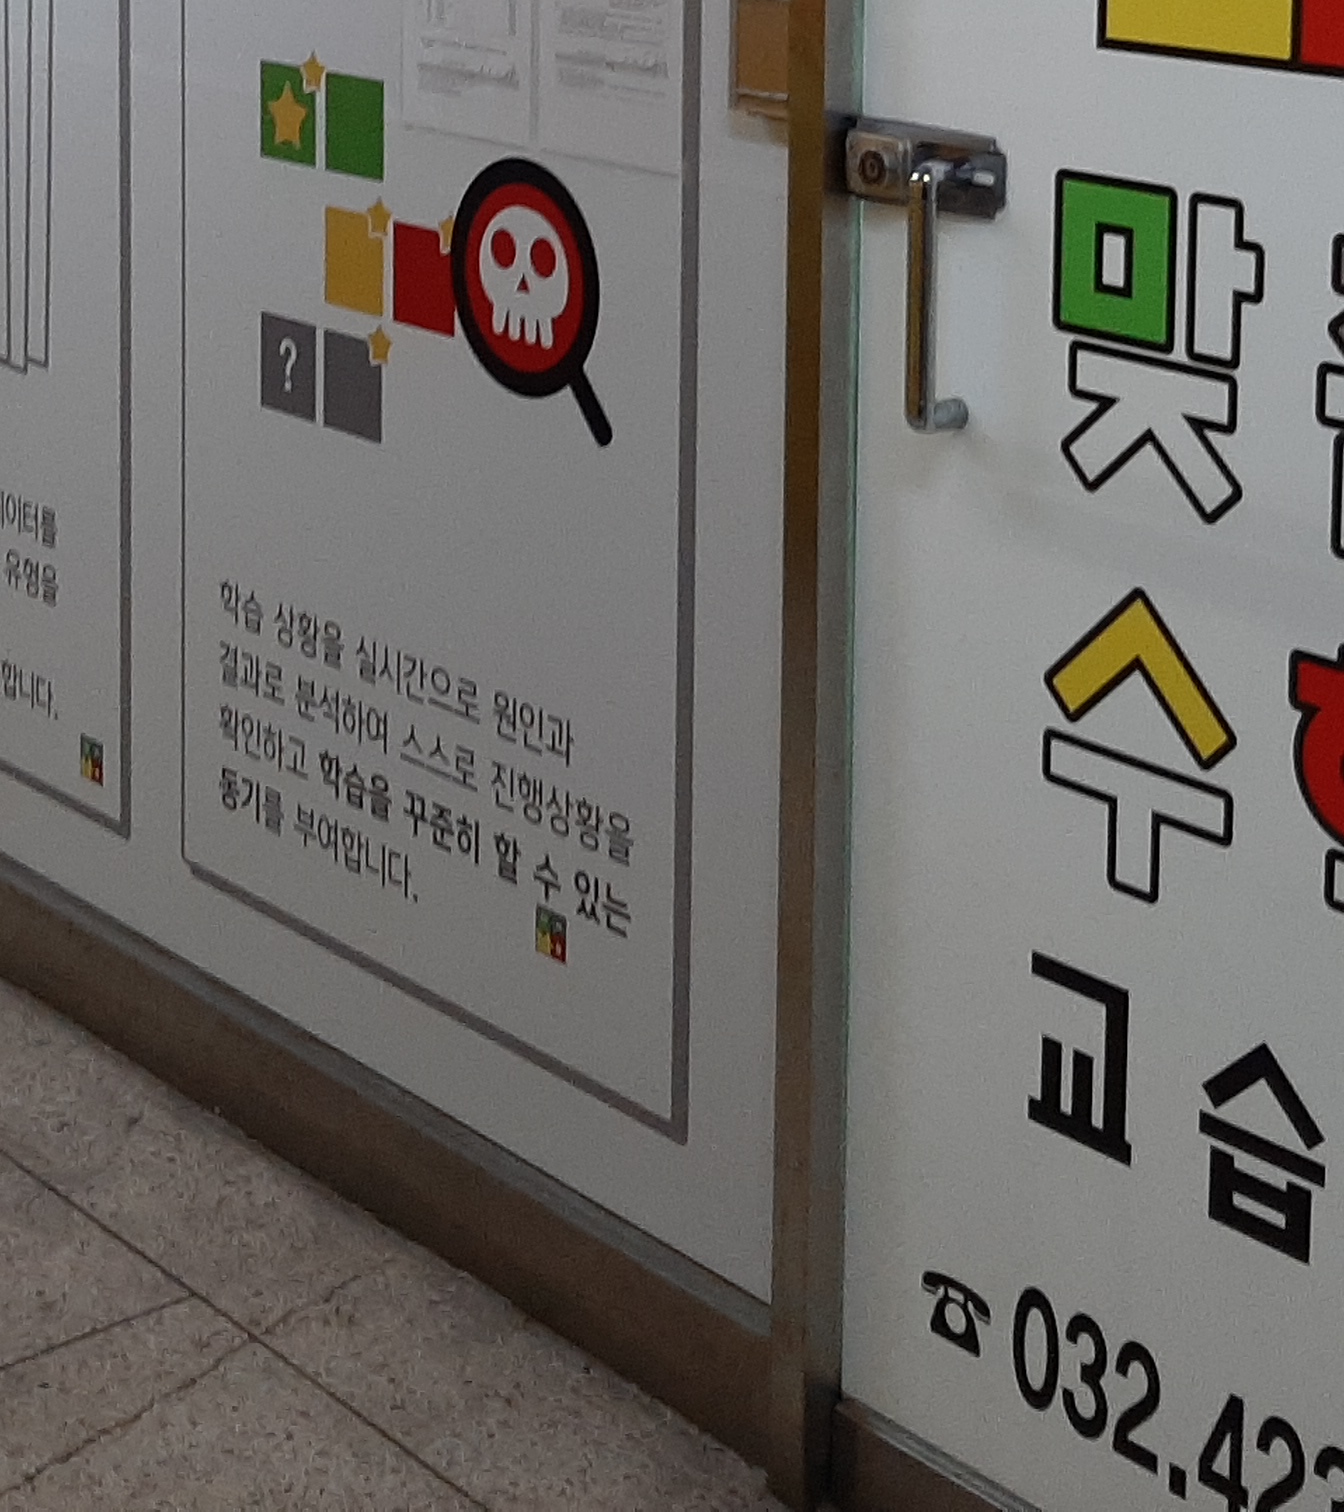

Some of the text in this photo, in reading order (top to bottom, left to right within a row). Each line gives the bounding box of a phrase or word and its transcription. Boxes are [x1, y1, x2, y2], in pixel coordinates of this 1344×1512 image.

[4, 548, 58, 607] 유형을
[219, 579, 575, 768] 학습 상황을 실시간으로 원인과
[219, 639, 634, 867] 결과로 분석하여 스스로 진행상황을
[219, 703, 632, 938] 확인하고 학습을 꾸준히 할 수 있는
[219, 766, 420, 904] 동기를 부여합니다.
